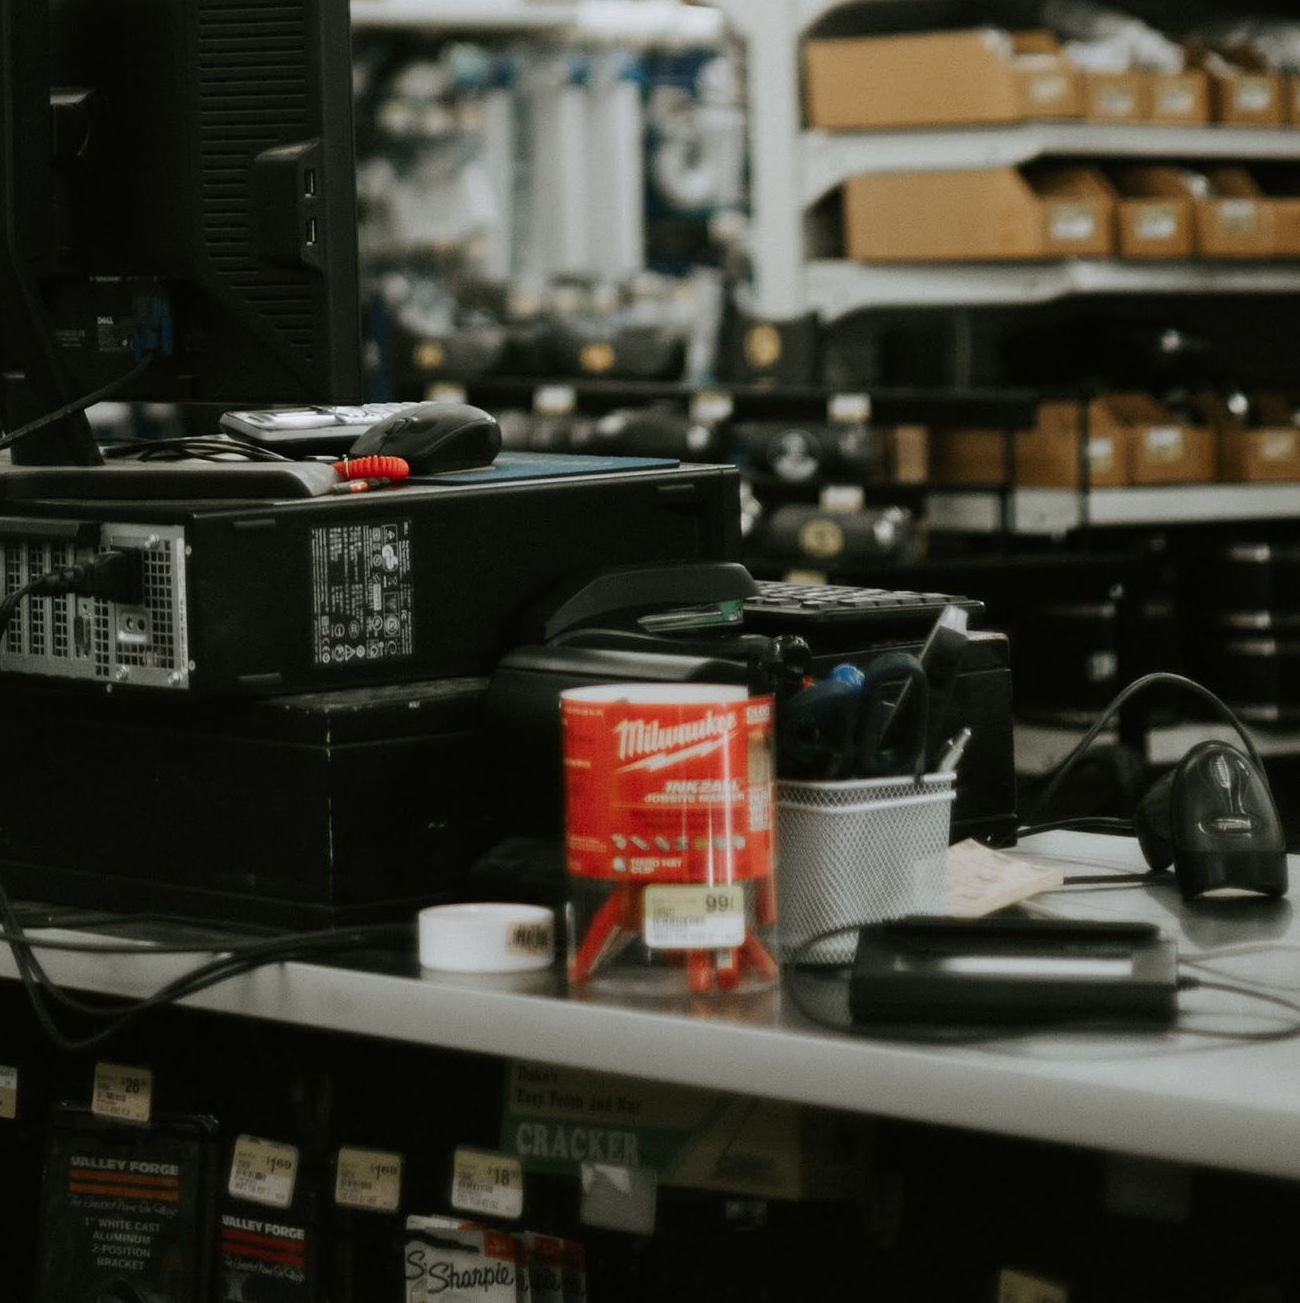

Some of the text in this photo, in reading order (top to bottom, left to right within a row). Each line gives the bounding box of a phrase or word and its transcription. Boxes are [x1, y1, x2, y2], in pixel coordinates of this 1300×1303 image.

[612, 711, 738, 761] Milwaukee
[515, 1122, 639, 1166] CRACKER
[70, 1155, 179, 1176] VALLEY FORGE
[98, 1218, 132, 1230] WHITE
[134, 1222, 160, 1233] CAST
[222, 1214, 306, 1240] VALLEY FORGE
[92, 1231, 151, 1245] ALUMINUM
[92, 1243, 151, 1258] 2-POSITION
[96, 1257, 145, 1271] BRACKET
[428, 1261, 514, 1293] Sharpie
